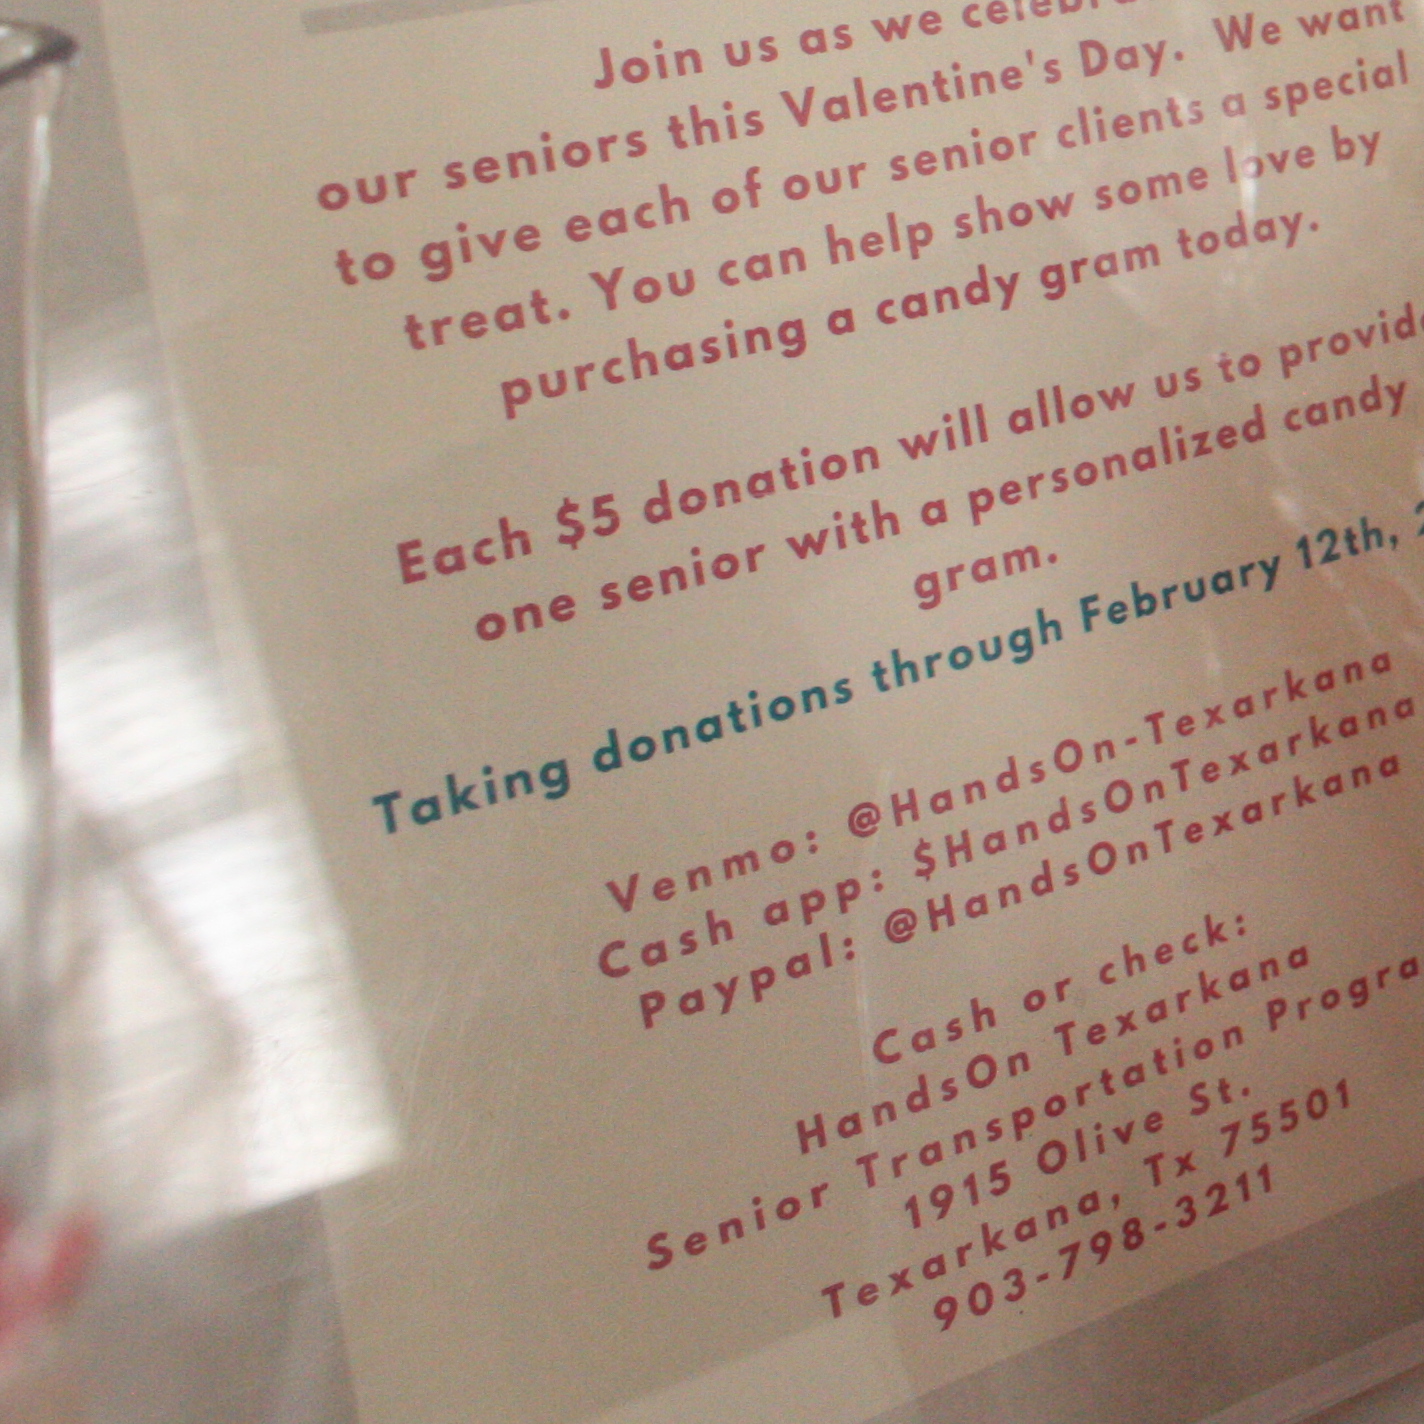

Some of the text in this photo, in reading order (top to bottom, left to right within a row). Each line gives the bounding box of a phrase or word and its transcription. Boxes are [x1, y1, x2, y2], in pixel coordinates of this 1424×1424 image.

[317, 168, 418, 212] our
[444, 130, 648, 190] seniors
[667, 100, 765, 150] this
[779, 49, 1062, 128] Valentine's
[1078, 39, 1184, 78] Day.
[1213, 12, 1281, 53] We
[594, 39, 703, 90] Join
[723, 35, 779, 68] us
[799, 23, 854, 56] as
[871, 10, 942, 43] we
[335, 48, 1409, 286] to give each of our senior clients a special
[403, 124, 1381, 351] treat. You can help show some love by
[500, 210, 1319, 420] purchasing a candy gram today.
[396, 516, 533, 585] Each
[556, 493, 621, 550] $5
[643, 445, 880, 525] donation
[898, 403, 989, 460] will
[1007, 382, 1135, 435] allow
[1154, 366, 1203, 399] us
[1217, 352, 1262, 383] to
[475, 374, 1407, 642] one senior with a personalized candy
[913, 544, 1058, 611] gram.
[371, 759, 571, 834] Taking
[592, 678, 853, 773] donations
[870, 608, 1063, 693] through
[1079, 555, 1281, 633] February
[1296, 517, 1399, 570] 12th,
[605, 652, 1392, 913] Venmo: @HandsOn-Texarkana
[598, 697, 1415, 979] Cash app: $HandsOnTexarkana
[639, 755, 1400, 1030] Paypal: @HandsOnTexarkana
[795, 945, 1310, 1155] HandsOn Texarkana
[872, 914, 1246, 1065] Cash or check:
[647, 1182, 829, 1271] Senior
[855, 1025, 1244, 1188] Transportation
[820, 1078, 1350, 1319] Texarkana, Tx 75501
[904, 1078, 1250, 1229] 1915 Olive St.
[933, 1163, 1272, 1332] 903-798-3211
